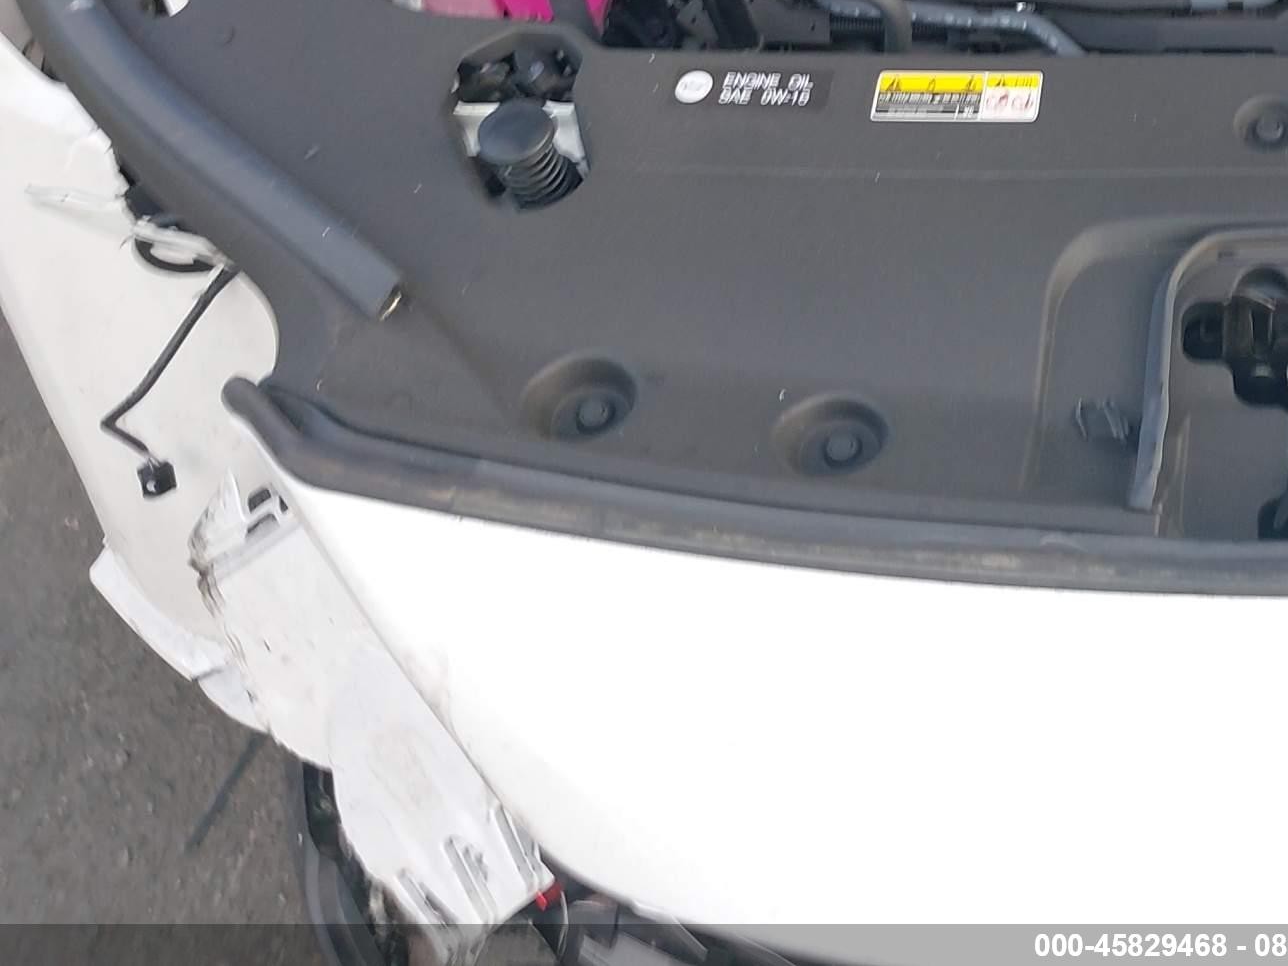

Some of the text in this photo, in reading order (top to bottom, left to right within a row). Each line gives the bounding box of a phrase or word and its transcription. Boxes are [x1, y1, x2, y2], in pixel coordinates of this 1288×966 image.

[722, 71, 781, 91] ENGINE
[788, 73, 813, 91] OIL
[718, 87, 752, 105] SAE
